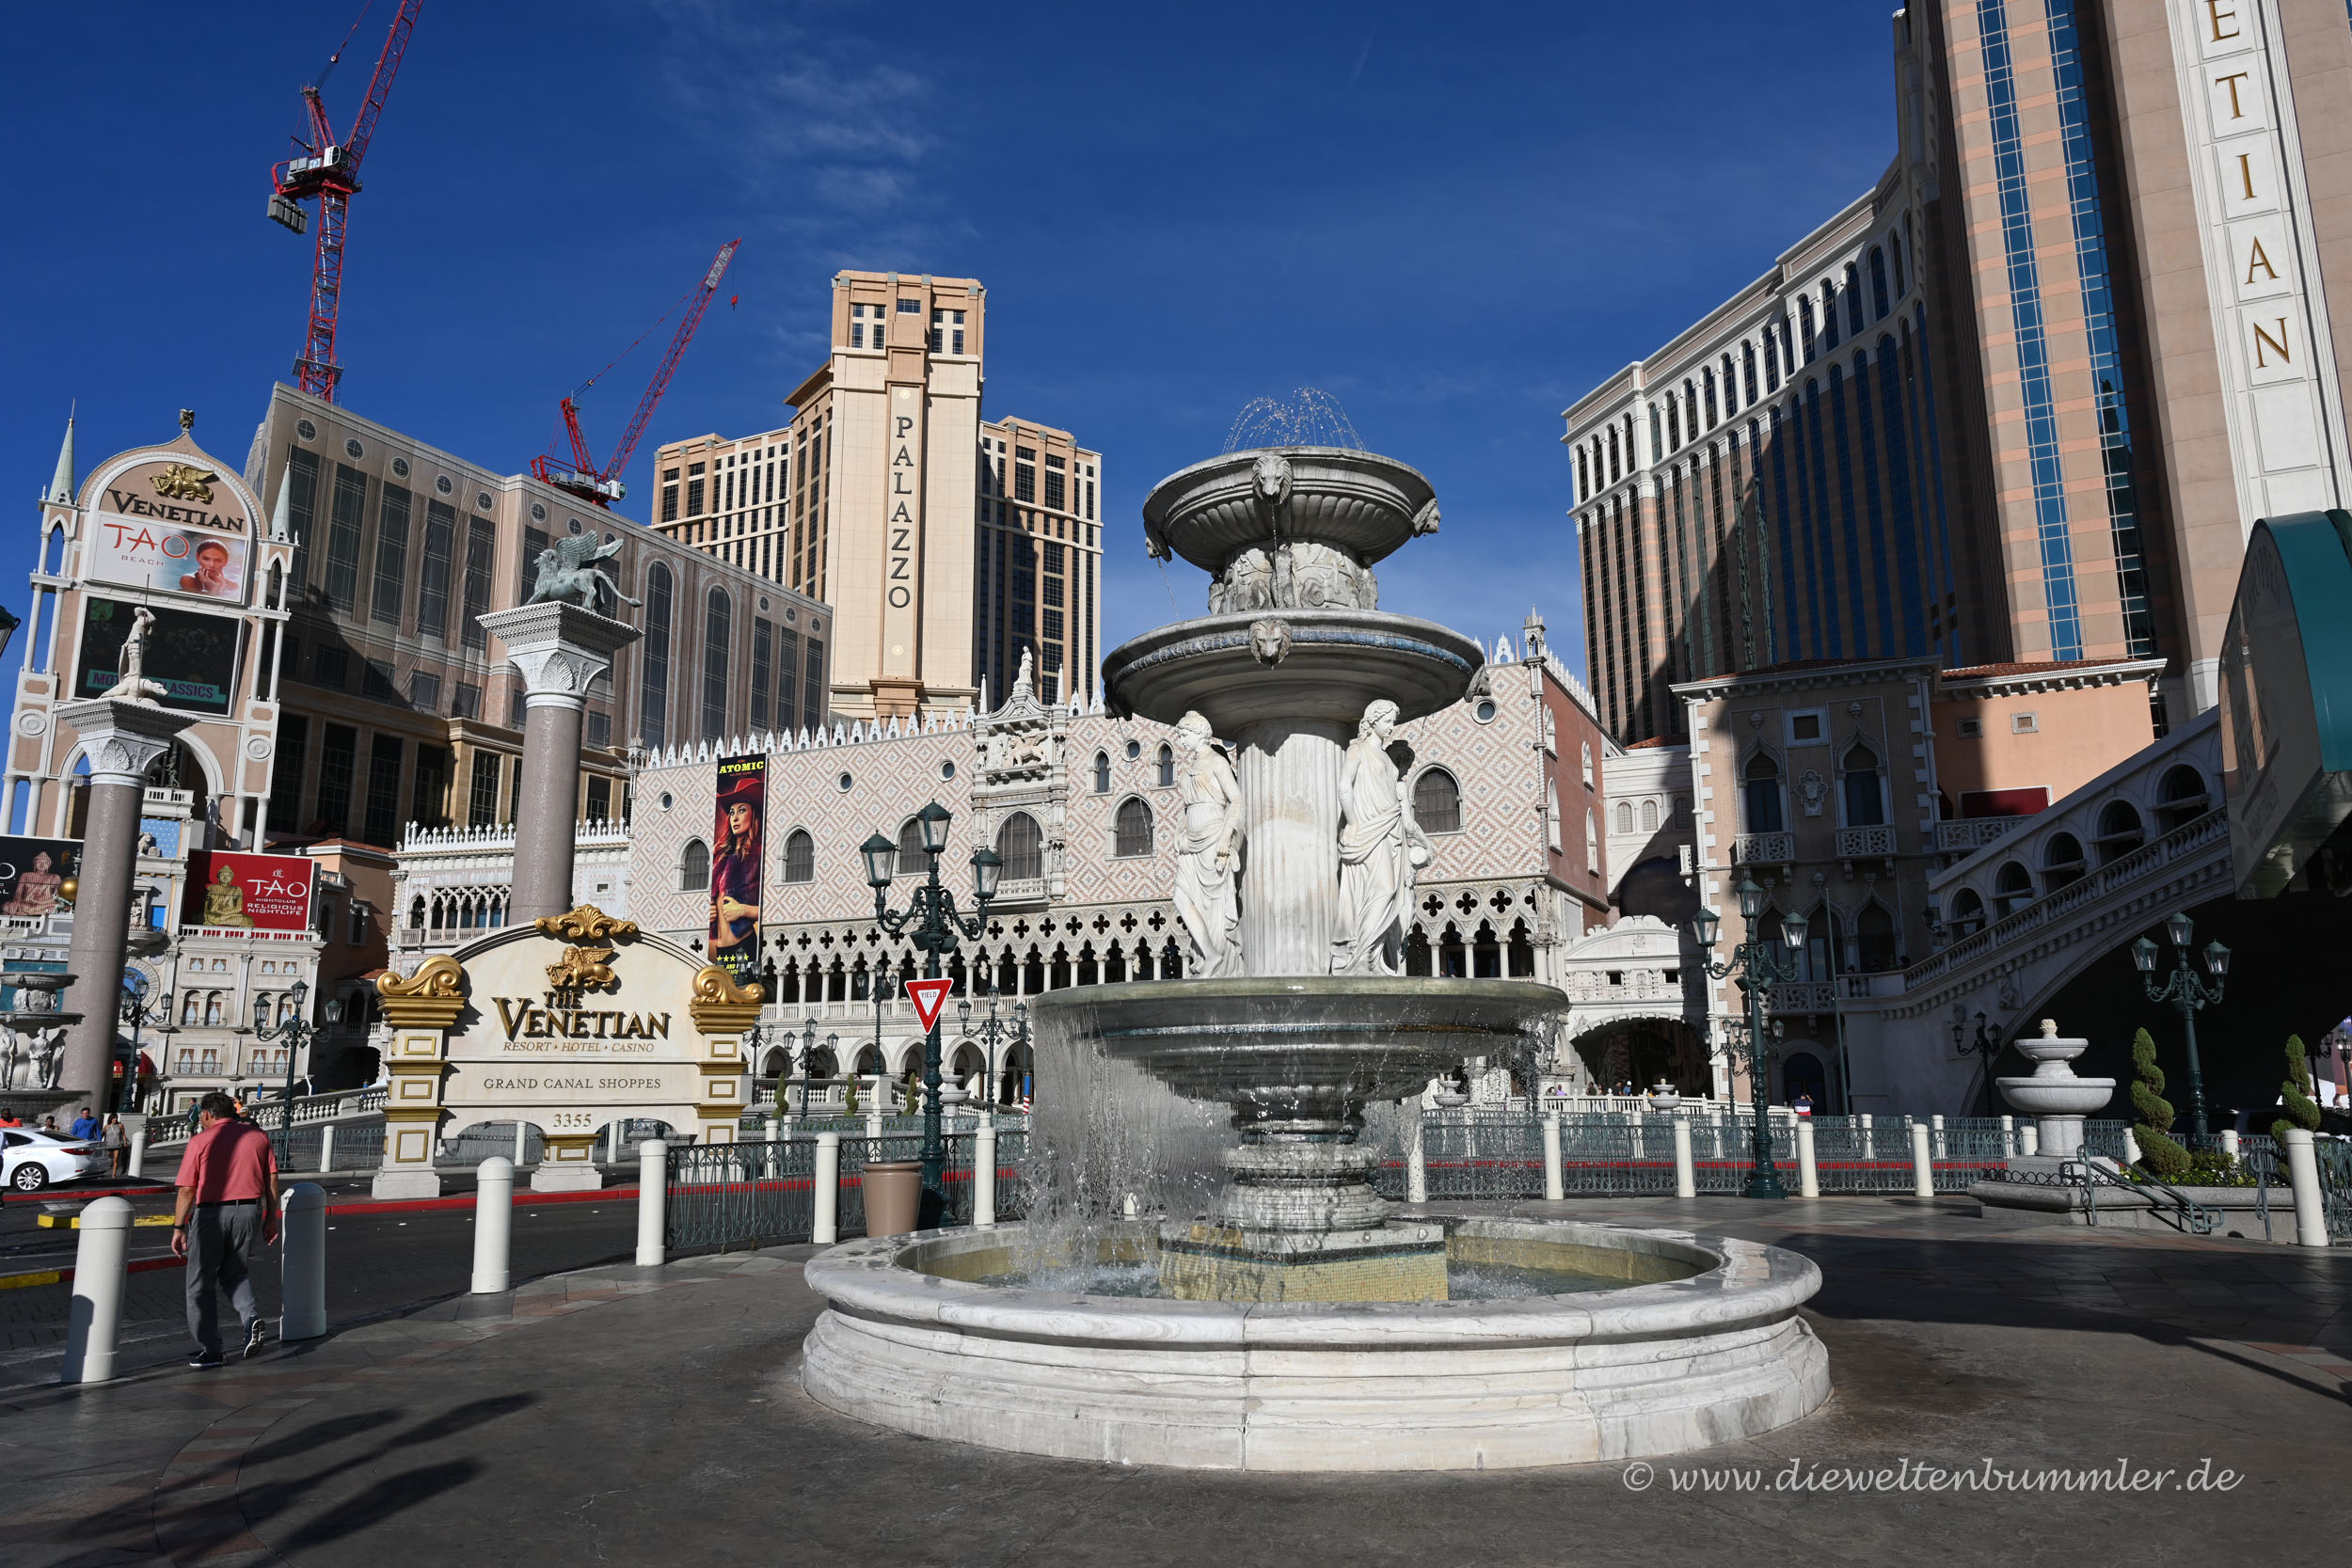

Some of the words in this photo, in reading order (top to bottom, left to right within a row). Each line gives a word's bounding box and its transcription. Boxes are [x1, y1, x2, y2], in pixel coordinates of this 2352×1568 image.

[106, 489, 245, 533] VENETIAN
[888, 416, 914, 609] PALAZZO
[103, 523, 190, 559] TAO
[120, 554, 165, 567] BEACH
[719, 761, 764, 774] ATOMIC
[246, 879, 308, 897] TAO
[544, 990, 583, 1007] THE
[491, 997, 672, 1041] VENETIAN
[503, 1041, 552, 1052] RESORT
[561, 1042, 601, 1052] HOTEL
[612, 1042, 655, 1053] CASINO
[484, 1078, 538, 1089] GRAND
[544, 1078, 594, 1089] CANAL
[598, 1078, 661, 1089] SHOPPES
[553, 1113, 592, 1128] 3355
